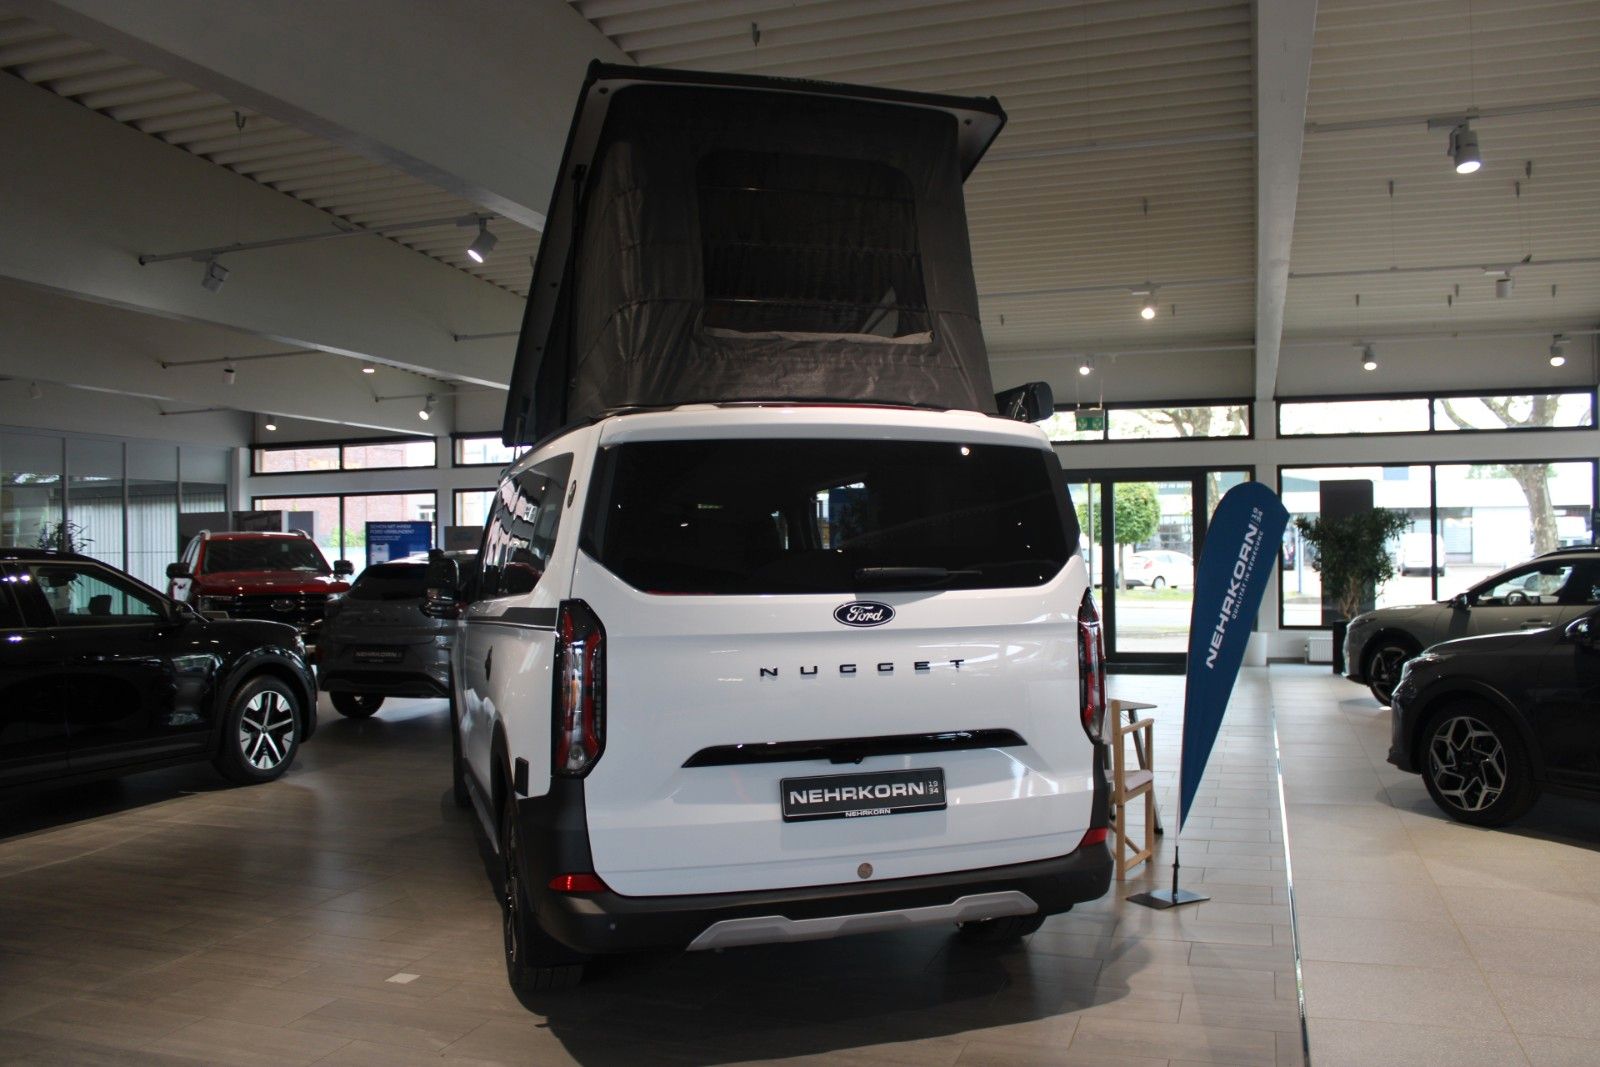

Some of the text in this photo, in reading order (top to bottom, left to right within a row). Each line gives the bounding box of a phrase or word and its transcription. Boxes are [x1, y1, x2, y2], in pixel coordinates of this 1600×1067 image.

[1205, 523, 1258, 669] NEHRKORN
[760, 659, 965, 677] NUGGET
[789, 781, 924, 805] NEHRKORN
[845, 808, 891, 817] NEHRKORN
